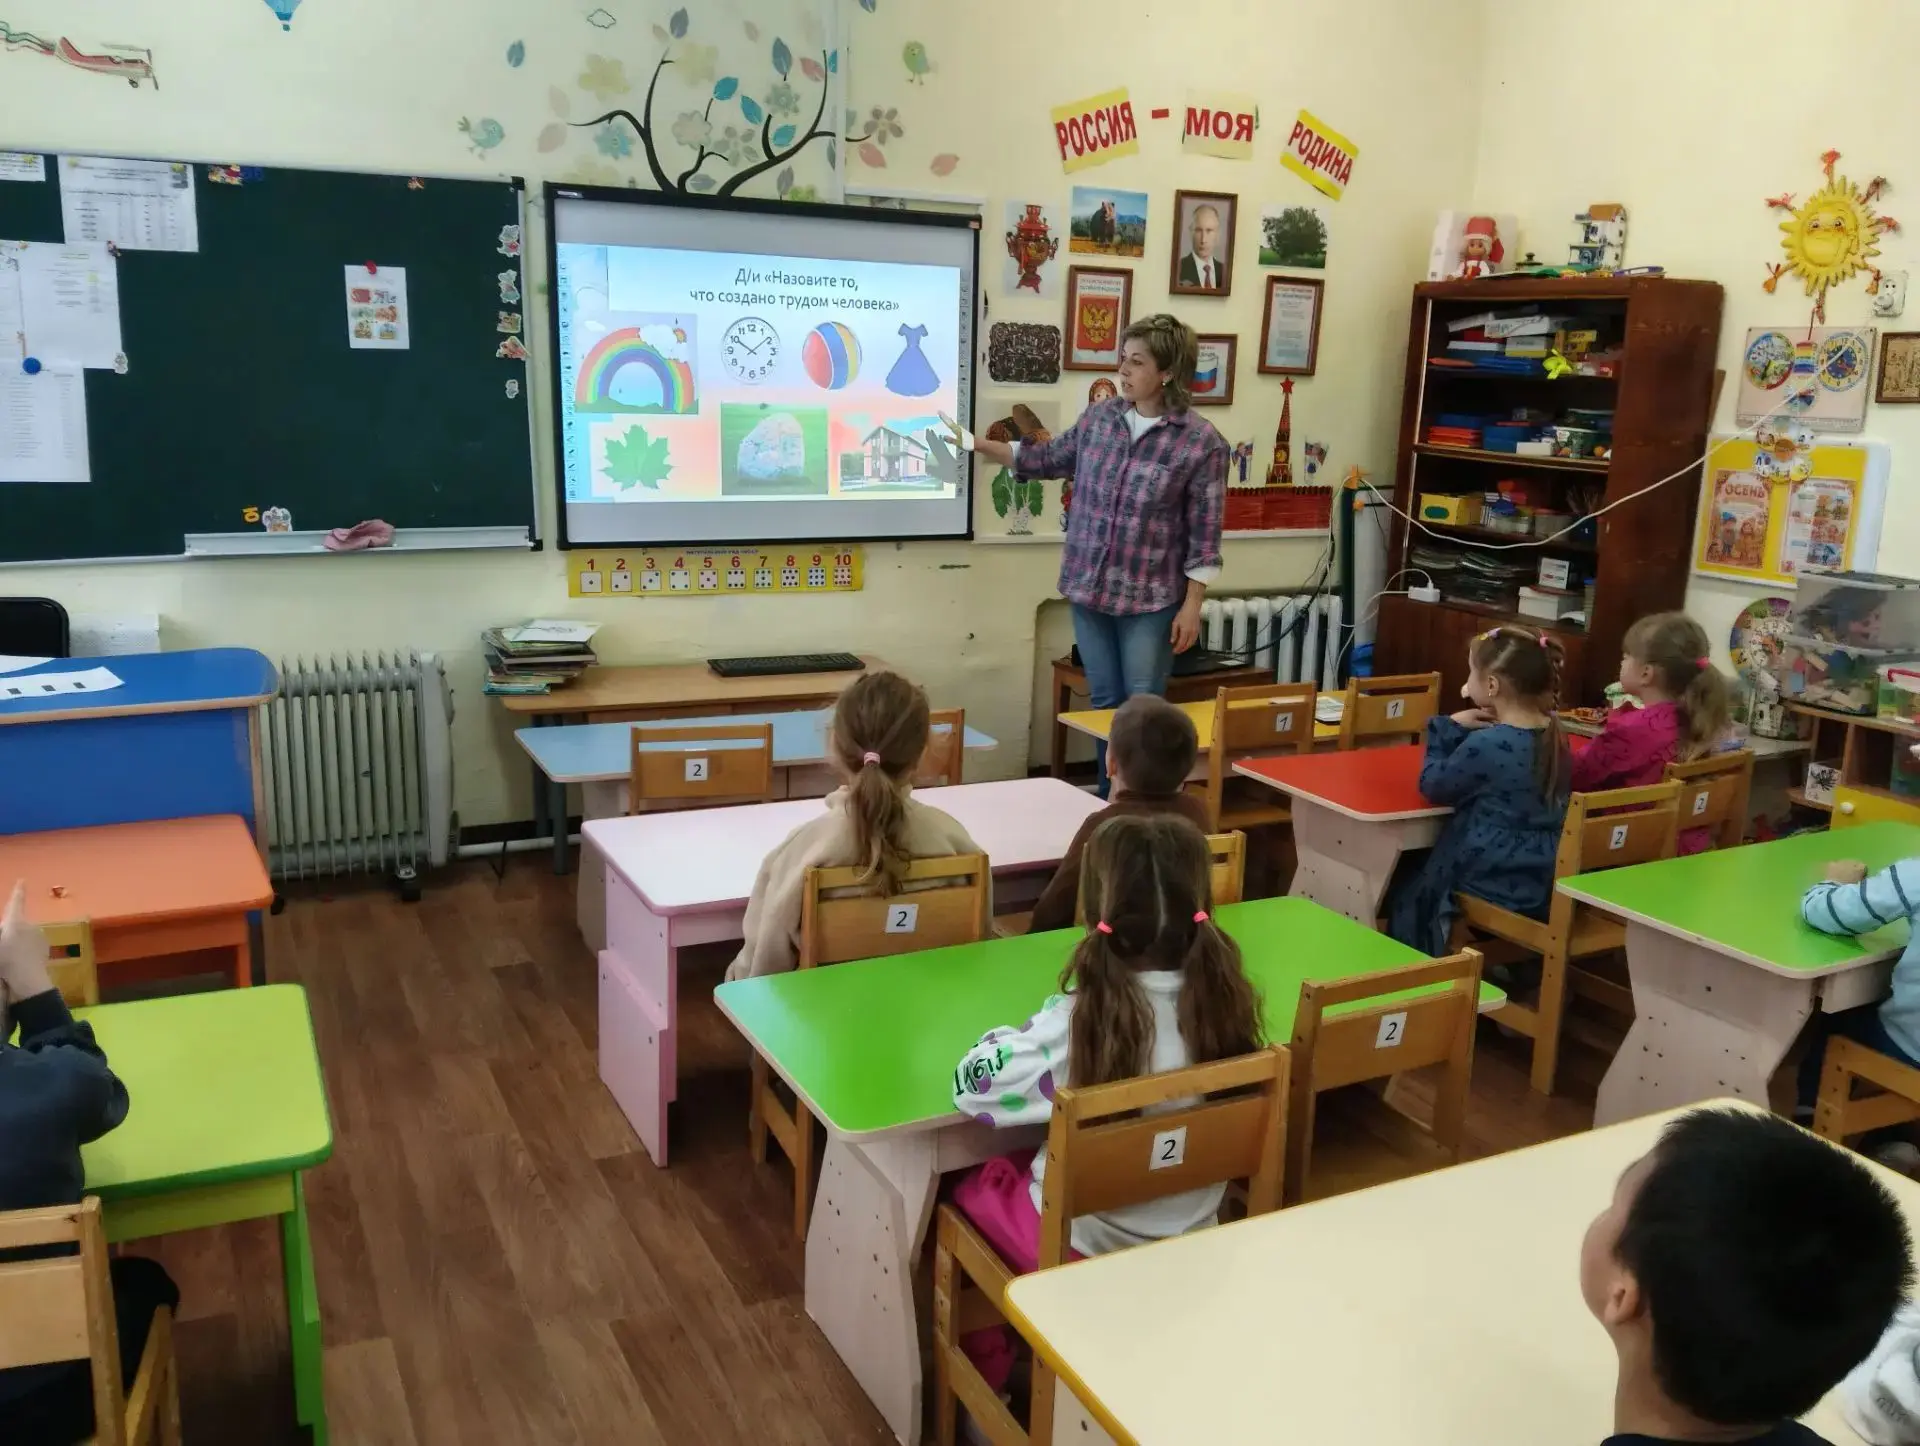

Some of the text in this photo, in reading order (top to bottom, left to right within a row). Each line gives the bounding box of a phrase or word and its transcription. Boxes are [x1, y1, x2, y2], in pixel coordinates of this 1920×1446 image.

[1055, 101, 1137, 161] РОССИЯ
[1186, 107, 1254, 143] МОЯ
[1287, 120, 1353, 186] РОДИНА
[735, 267, 859, 291] Д/и «Назовите то,
[689, 289, 900, 311] что создано трудом человека»
[587, 554, 852, 571] 1 2 3 4 5 6 7 8 9 10
[1392, 702, 1399, 716] 1
[1279, 715, 1288, 730] 1
[693, 763, 702, 777] 2
[1615, 831, 1624, 845] 2
[896, 911, 908, 927] 2
[1385, 1021, 1398, 1040] 2
[1160, 1138, 1177, 1160] 2
